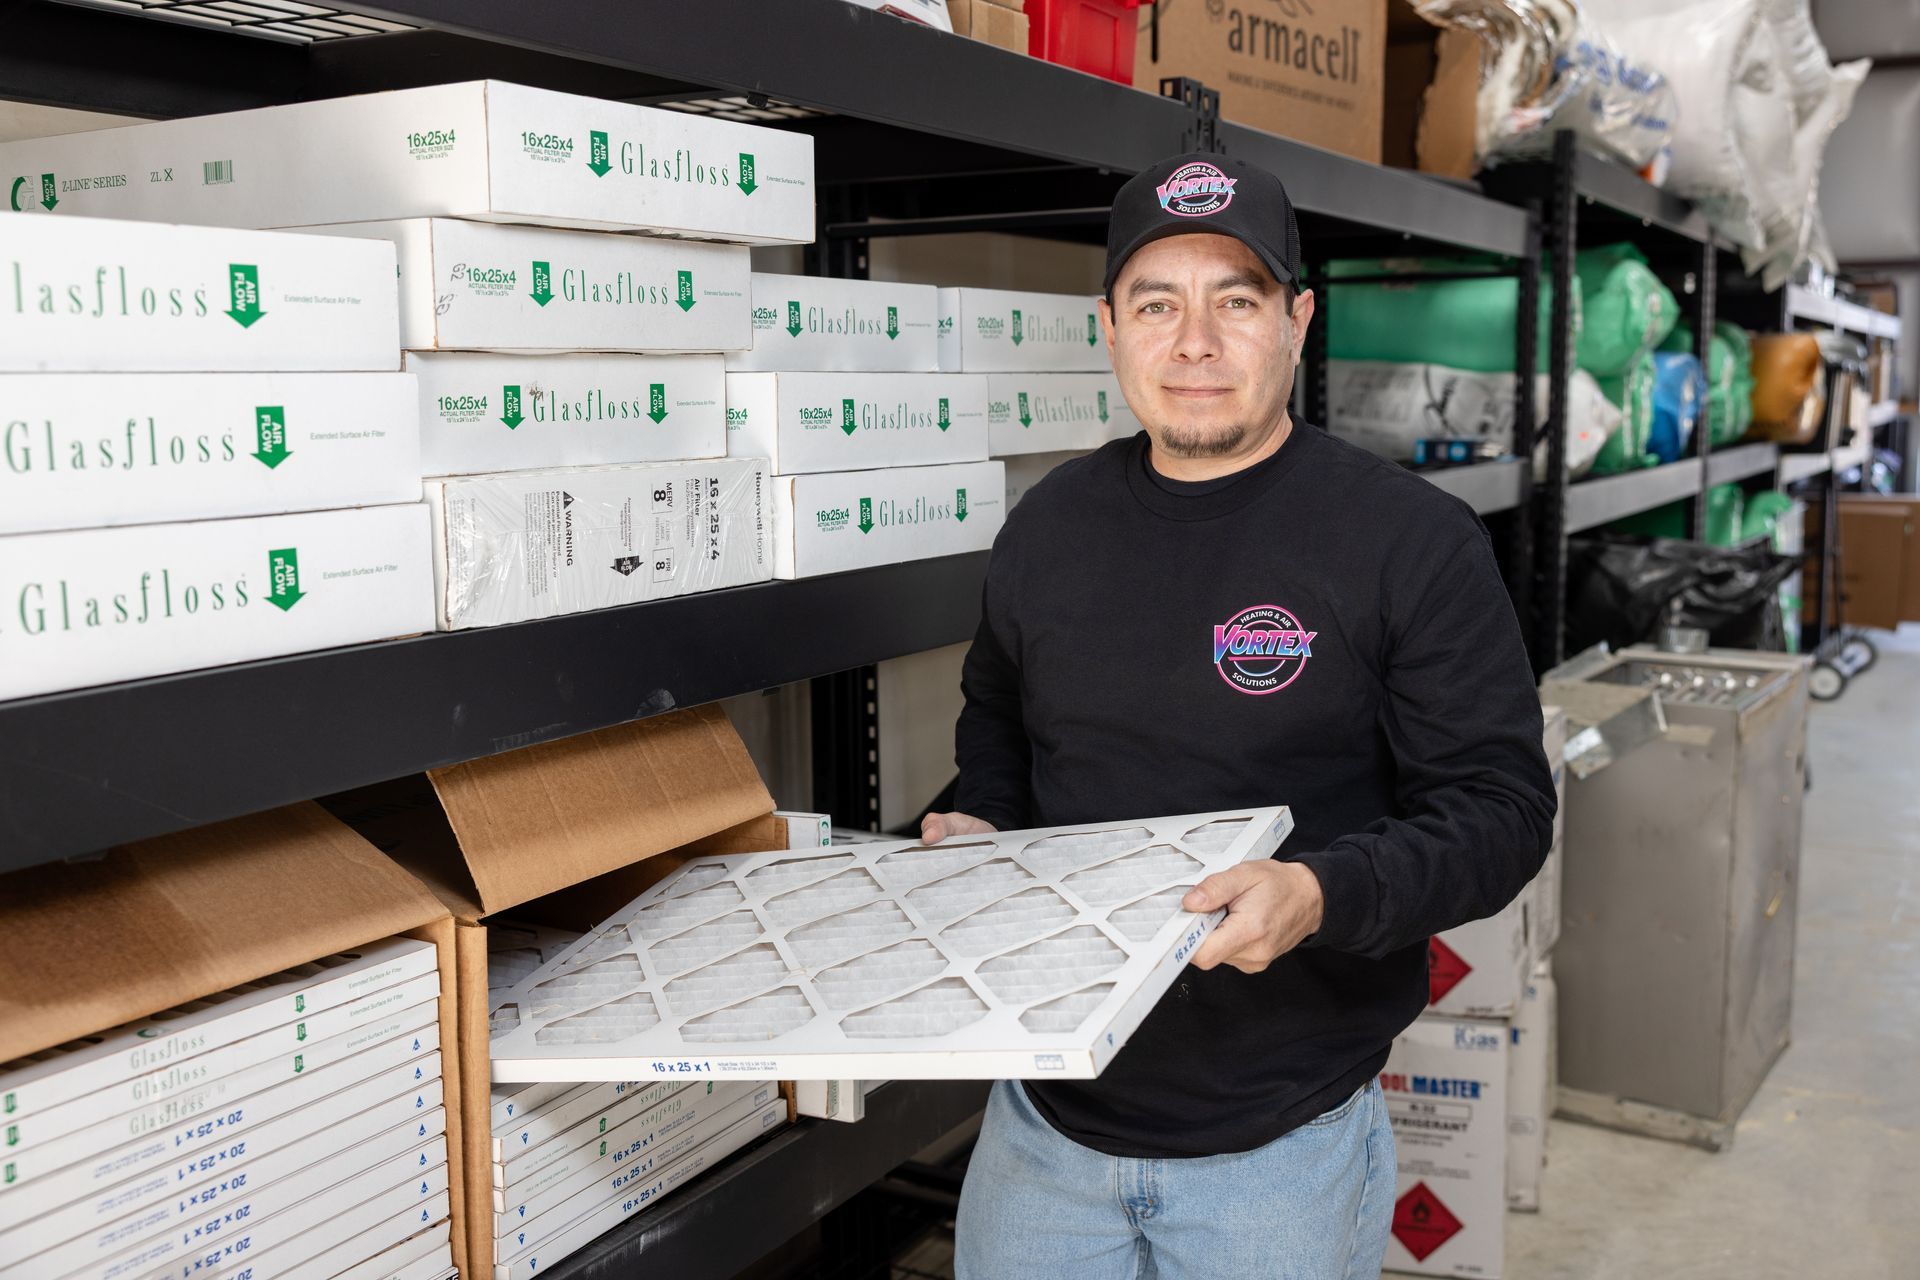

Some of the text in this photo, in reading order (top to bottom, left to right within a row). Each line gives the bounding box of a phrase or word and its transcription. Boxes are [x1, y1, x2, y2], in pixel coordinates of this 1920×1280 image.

[1228, 8, 1360, 85] armacell
[407, 129, 455, 148] 16x25x4
[521, 131, 574, 152] 16x25x4
[150, 168, 174, 183] ZL X
[621, 141, 729, 187] Glasfloss
[1176, 166, 1200, 180] HEATING
[93, 175, 127, 189] SERIES
[1156, 177, 1238, 209] VORTEX
[1177, 200, 1221, 213] SOLUTIONS
[13, 261, 208, 318] lasfloss
[466, 268, 516, 284] 16x25x4
[563, 268, 668, 305] Glasfloss
[234, 272, 246, 312] FLOW
[245, 281, 256, 304] AIR
[752, 307, 777, 319] x25x4
[809, 306, 881, 335] Glasfloss
[1028, 315, 1084, 342] Glasfloss
[438, 396, 487, 411] 16x25x4
[533, 389, 640, 422] Glasfloss
[799, 407, 832, 419] 16x25x4
[863, 402, 932, 430] Glasfloss
[4, 417, 235, 474] Glasfloss
[261, 414, 272, 453] FLOW
[272, 421, 283, 444] AIR
[653, 490, 667, 502] 8
[755, 472, 763, 531] Honeywell
[710, 478, 720, 560] 16 x 25 x 4
[816, 508, 849, 523] 16x25x4
[880, 497, 950, 527] Glasfloss
[565, 511, 574, 566] WARNING
[274, 557, 286, 595] FLOW
[285, 564, 296, 587] AIR
[656, 561, 665, 570] 8
[19, 569, 249, 635] Glasfloss
[1240, 611, 1273, 624] HEATING
[1280, 617, 1292, 628] AIR
[1213, 625, 1318, 664] VORTEX
[1232, 672, 1277, 687] SOLUTIONS
[1174, 952, 1183, 963] 16
[1183, 946, 1189, 954] x
[1187, 933, 1196, 948] 25
[1201, 922, 1205, 931] 1
[130, 1034, 206, 1069] Glasfloss
[132, 1064, 207, 1100] Glasfloss
[652, 1062, 666, 1073] 16
[668, 1064, 675, 1072] x
[678, 1062, 691, 1072] 25
[694, 1063, 702, 1072] x
[704, 1062, 711, 1071] 1
[1380, 1073, 1481, 1099] OOLMASTER
[176, 1110, 243, 1147] 20 x 25 x 1
[641, 1099, 682, 1128] Glasfloss
[178, 1142, 245, 1180] 20 x 25 x 1
[613, 1151, 622, 1163] 16
[624, 1148, 629, 1156] x
[631, 1141, 641, 1153] 25
[649, 1133, 654, 1142] 1
[612, 1177, 622, 1189] 16
[623, 1174, 628, 1182] x
[630, 1167, 640, 1179] 25
[648, 1158, 653, 1167] 1
[179, 1174, 246, 1213] 20 x 25 x 1
[623, 1200, 632, 1212] 16
[640, 1190, 650, 1202] 25
[658, 1181, 663, 1190] 1
[184, 1205, 251, 1245] 20 x 25 x 1
